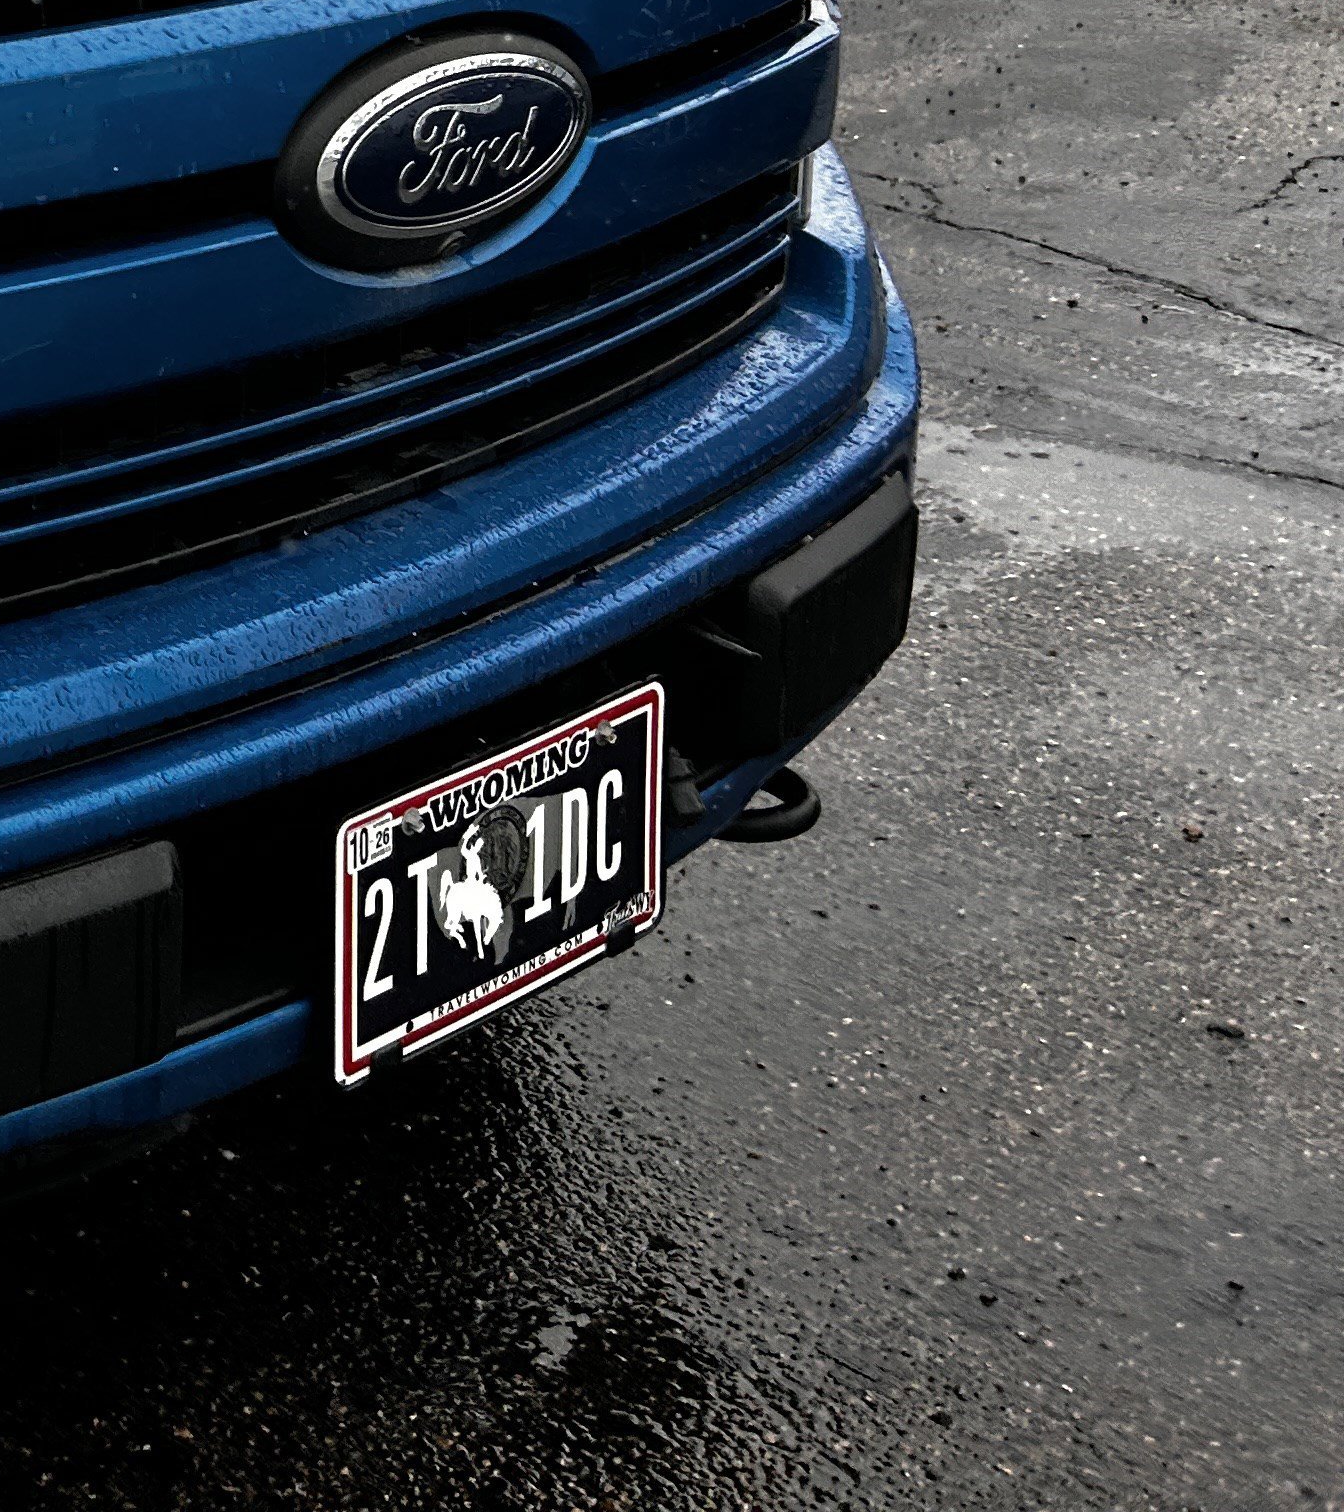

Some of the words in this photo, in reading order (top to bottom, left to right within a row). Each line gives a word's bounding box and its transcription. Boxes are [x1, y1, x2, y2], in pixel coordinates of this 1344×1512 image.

[398, 93, 539, 204] Ford
[427, 727, 590, 832] WYOMING
[349, 827, 369, 870] 10
[375, 827, 391, 849] 26
[362, 852, 440, 1003] 2T
[524, 768, 623, 924] 1DC
[429, 933, 584, 1022] TRAVELWYOMING.COM
